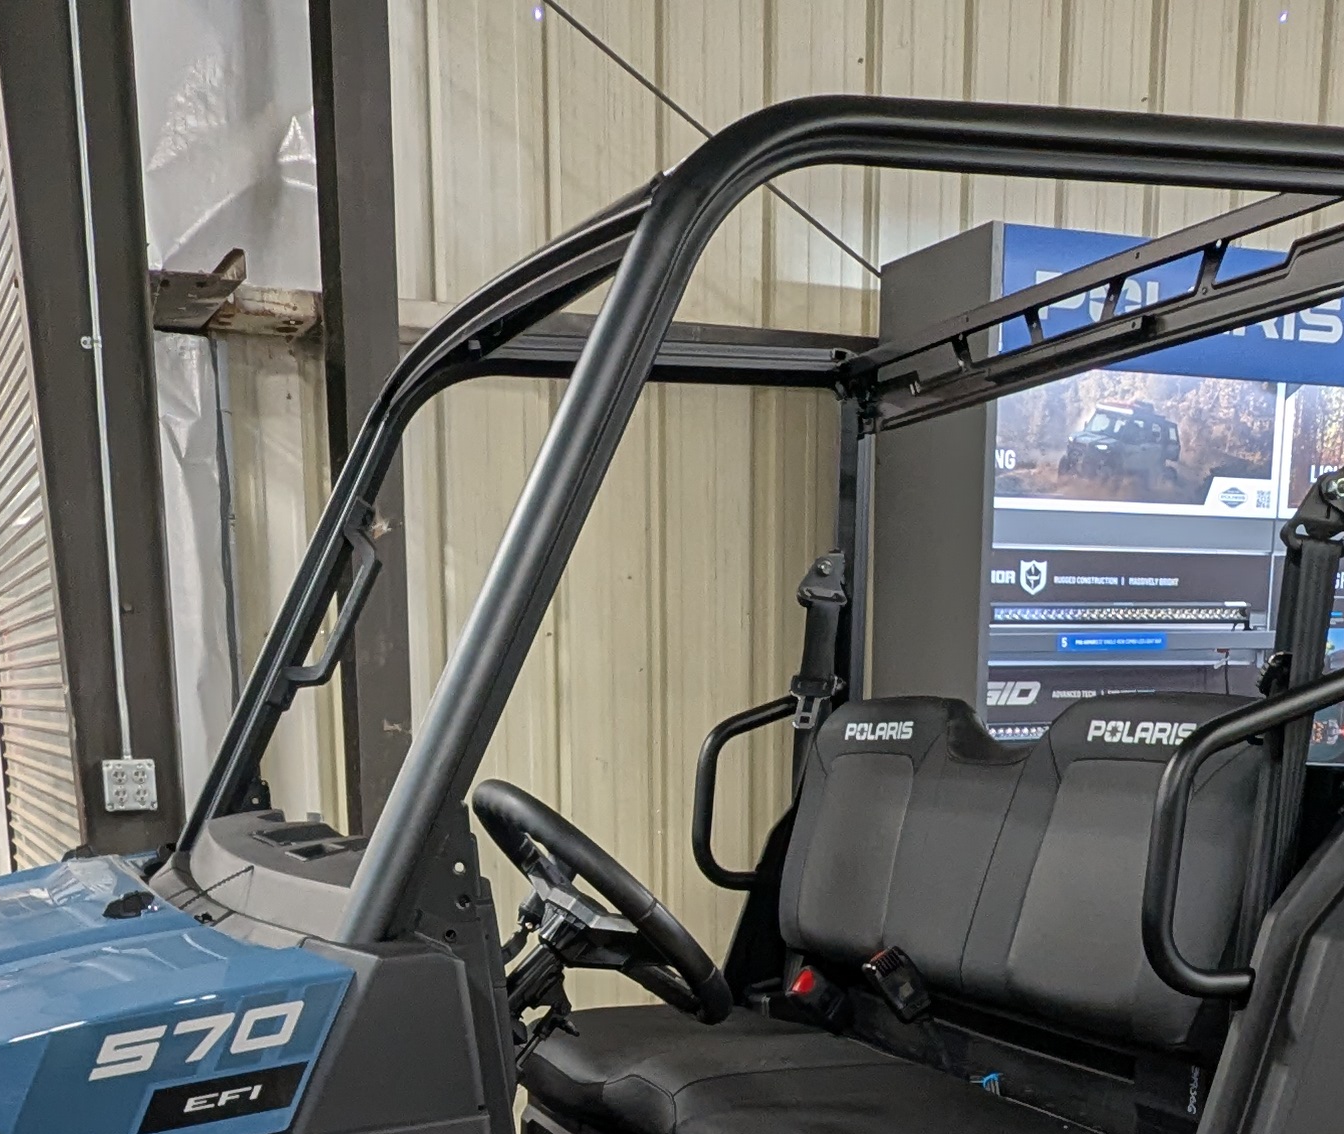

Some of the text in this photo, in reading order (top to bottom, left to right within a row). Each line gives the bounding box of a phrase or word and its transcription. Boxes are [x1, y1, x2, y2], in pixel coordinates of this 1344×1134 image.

[845, 720, 914, 741] POLARIS
[1087, 719, 1198, 746] POLARIS
[88, 1000, 305, 1082] 570
[183, 1084, 263, 1114] EFI
